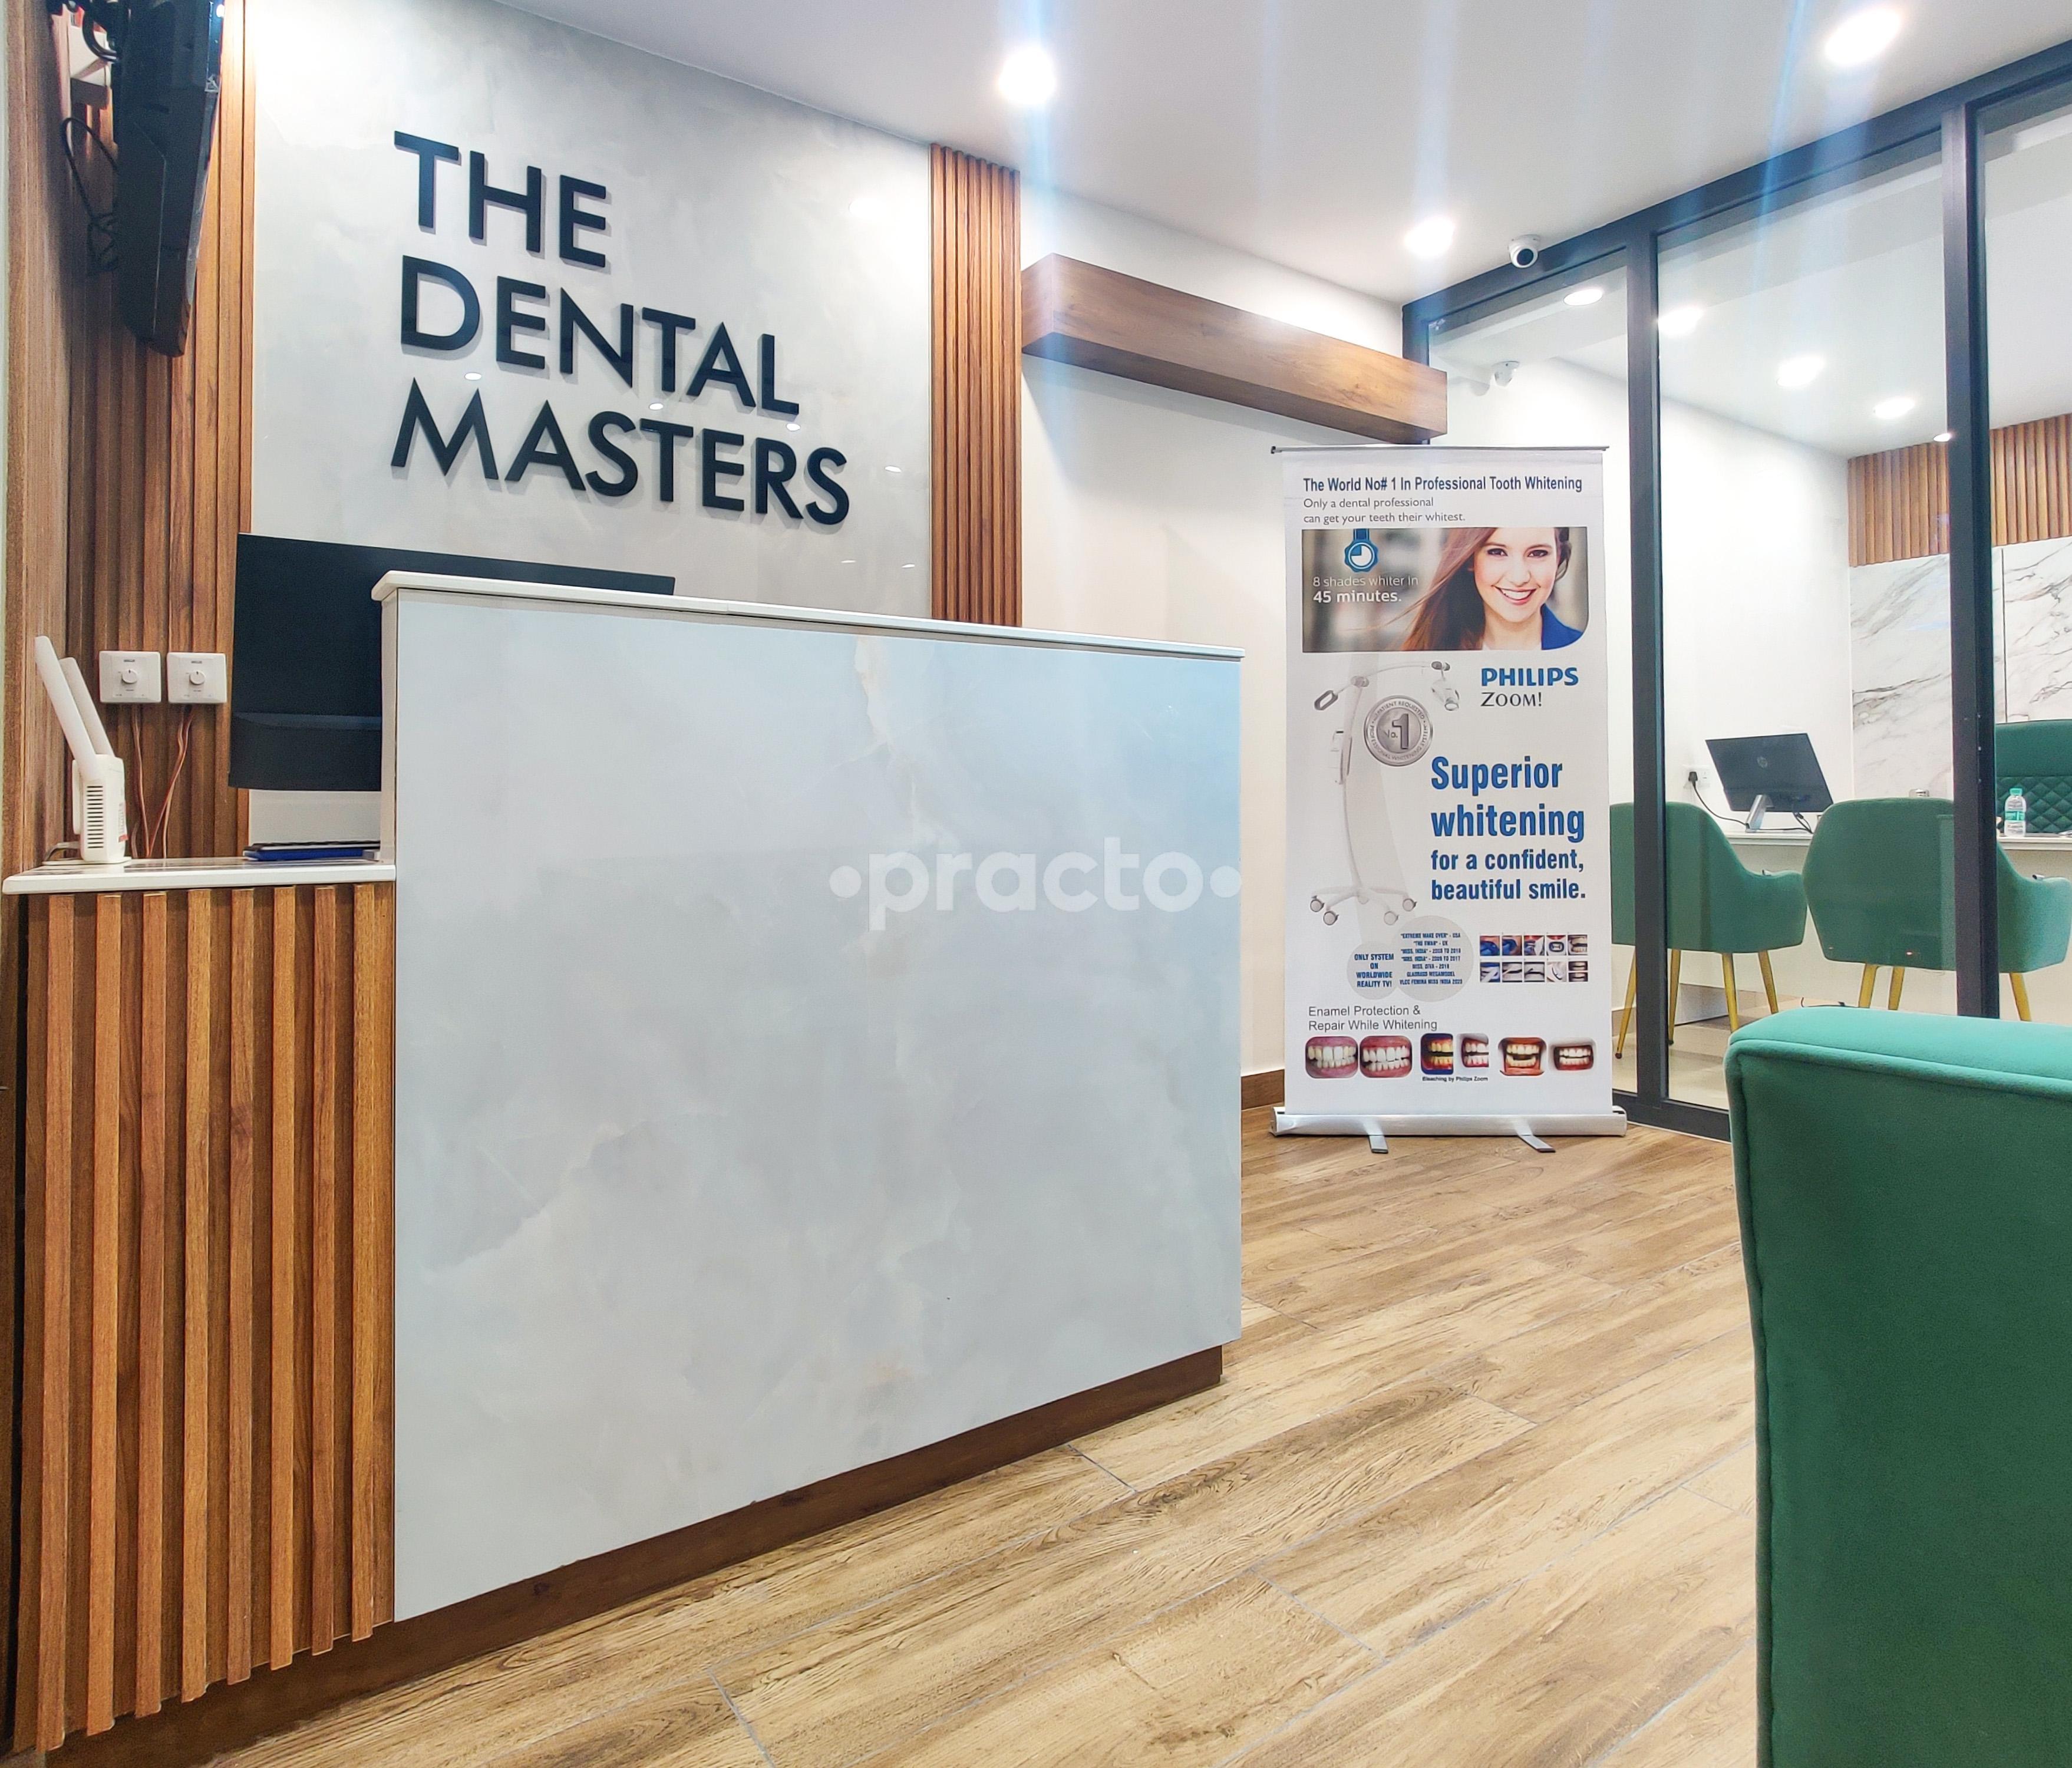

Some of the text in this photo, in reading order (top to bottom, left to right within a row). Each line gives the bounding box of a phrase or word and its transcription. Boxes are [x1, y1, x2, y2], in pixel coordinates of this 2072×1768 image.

[394, 130, 606, 268] THE
[401, 255, 799, 415] DENTAL
[390, 377, 850, 525] MASTERS
[1304, 476, 1582, 492] The World No# 1 In Professional Tooth Whitening
[1304, 499, 1328, 510] Only
[1339, 497, 1370, 507] dental
[1374, 497, 1433, 509] professional
[1324, 516, 1339, 525] get
[1342, 516, 1366, 525] your
[1370, 513, 1395, 522] teeth
[1398, 512, 1422, 522] their
[1426, 512, 1465, 521] whitest.
[1314, 575, 1418, 586] 8 shades whiter in
[1314, 590, 1402, 603] 45 minutes.
[1482, 667, 1578, 686] PHILIPS
[1481, 692, 1541, 706] ZOOM!
[1392, 713, 1409, 750] 1
[1431, 756, 1562, 796] Superior
[1431, 803, 1584, 843] whitening
[1431, 849, 1583, 872] for a confident,
[1432, 879, 1585, 900] beautiful smile.
[1309, 1005, 1420, 1016] Enamel Protection &
[1309, 1020, 1437, 1033] Repair While Whitening
